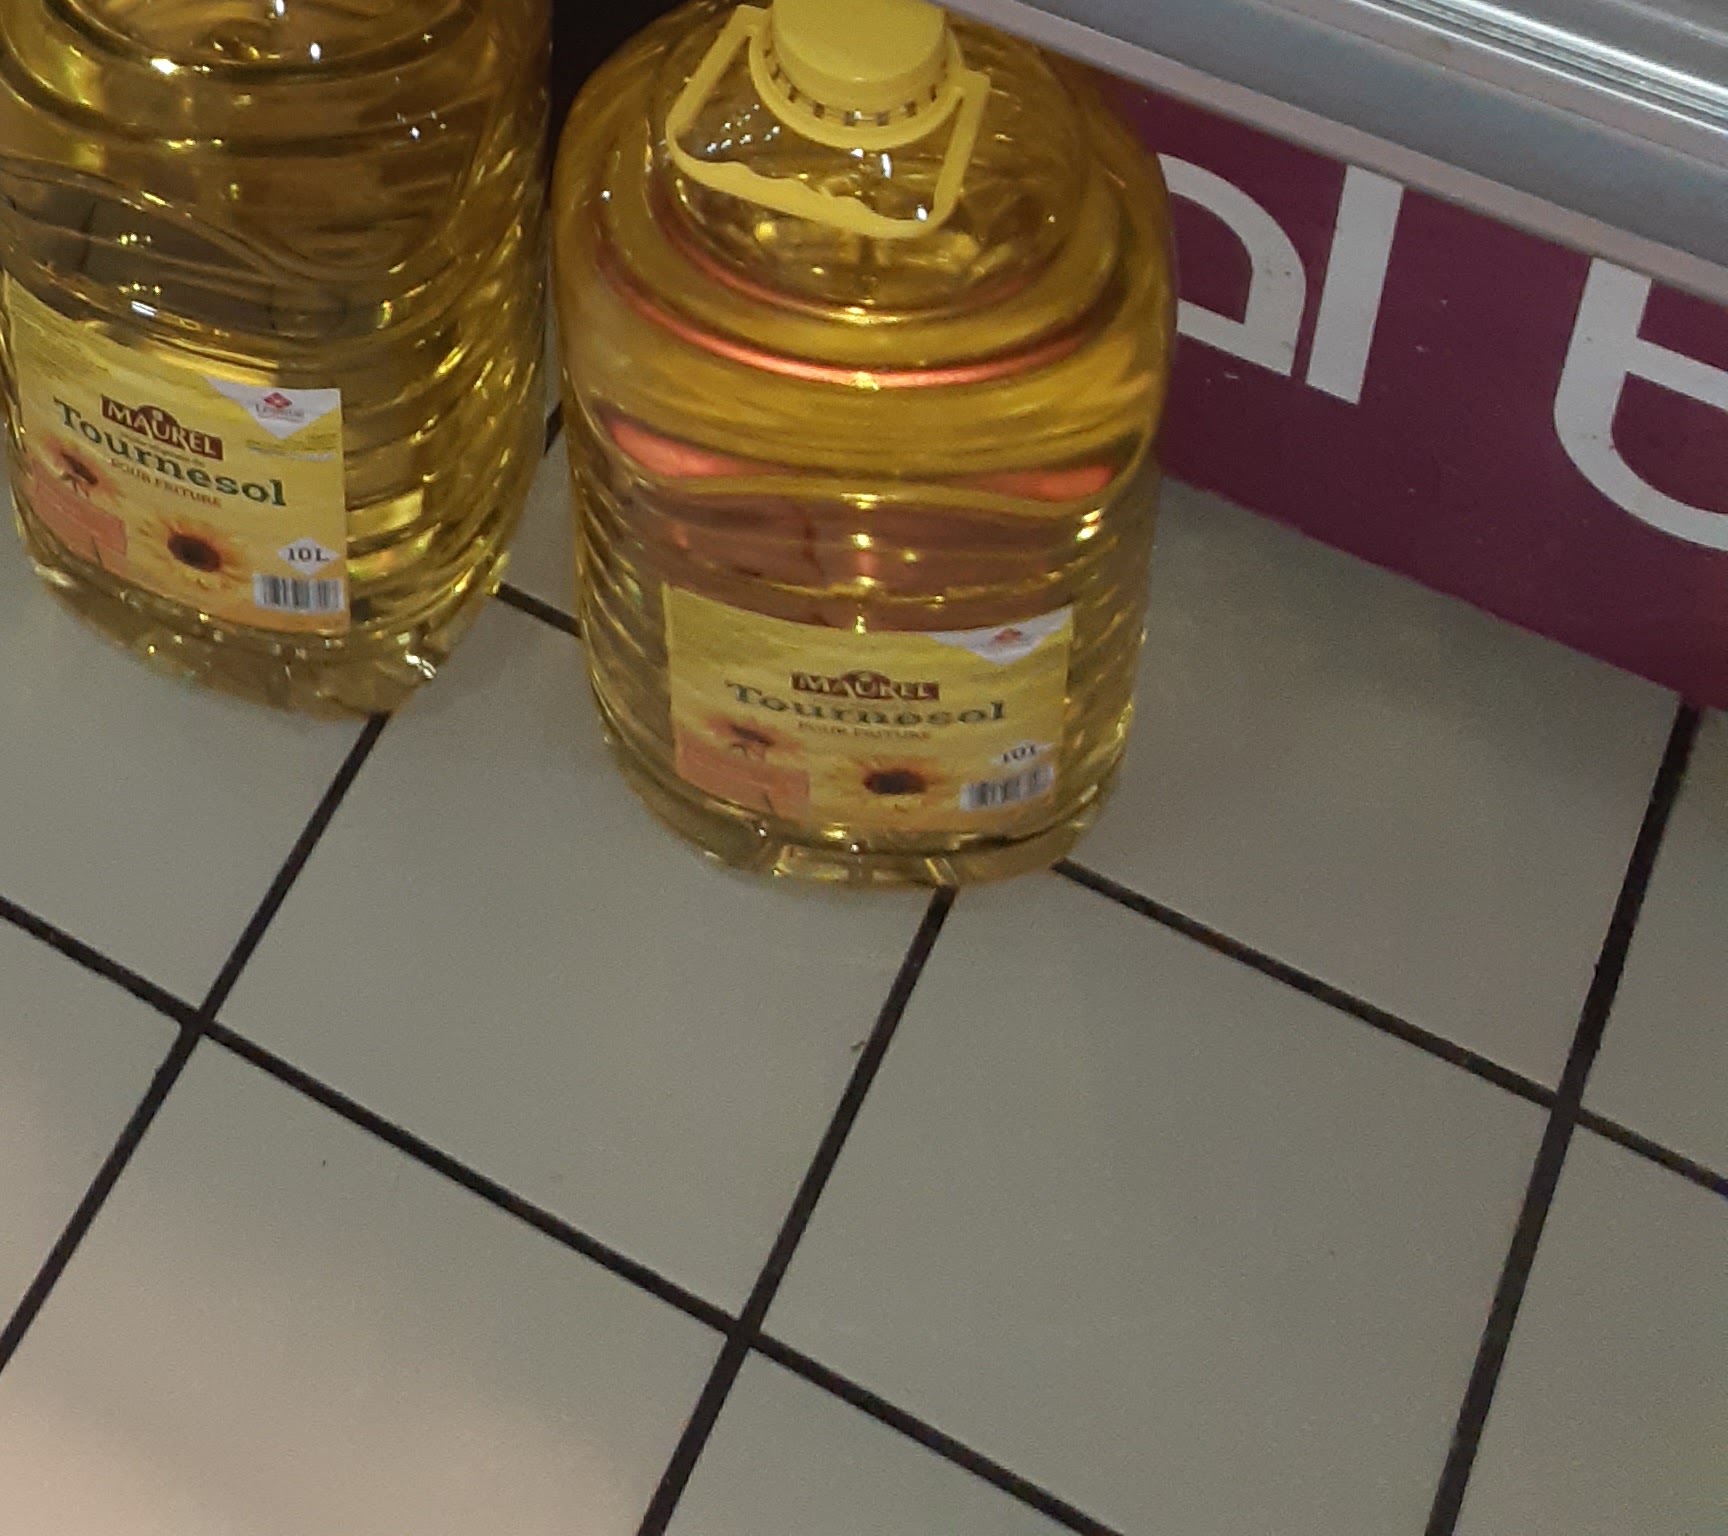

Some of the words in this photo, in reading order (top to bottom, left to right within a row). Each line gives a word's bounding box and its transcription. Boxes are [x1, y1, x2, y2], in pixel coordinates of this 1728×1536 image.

[52, 394, 287, 507] Tournesol
[108, 401, 217, 455] MAUREL
[285, 545, 331, 564] 10L
